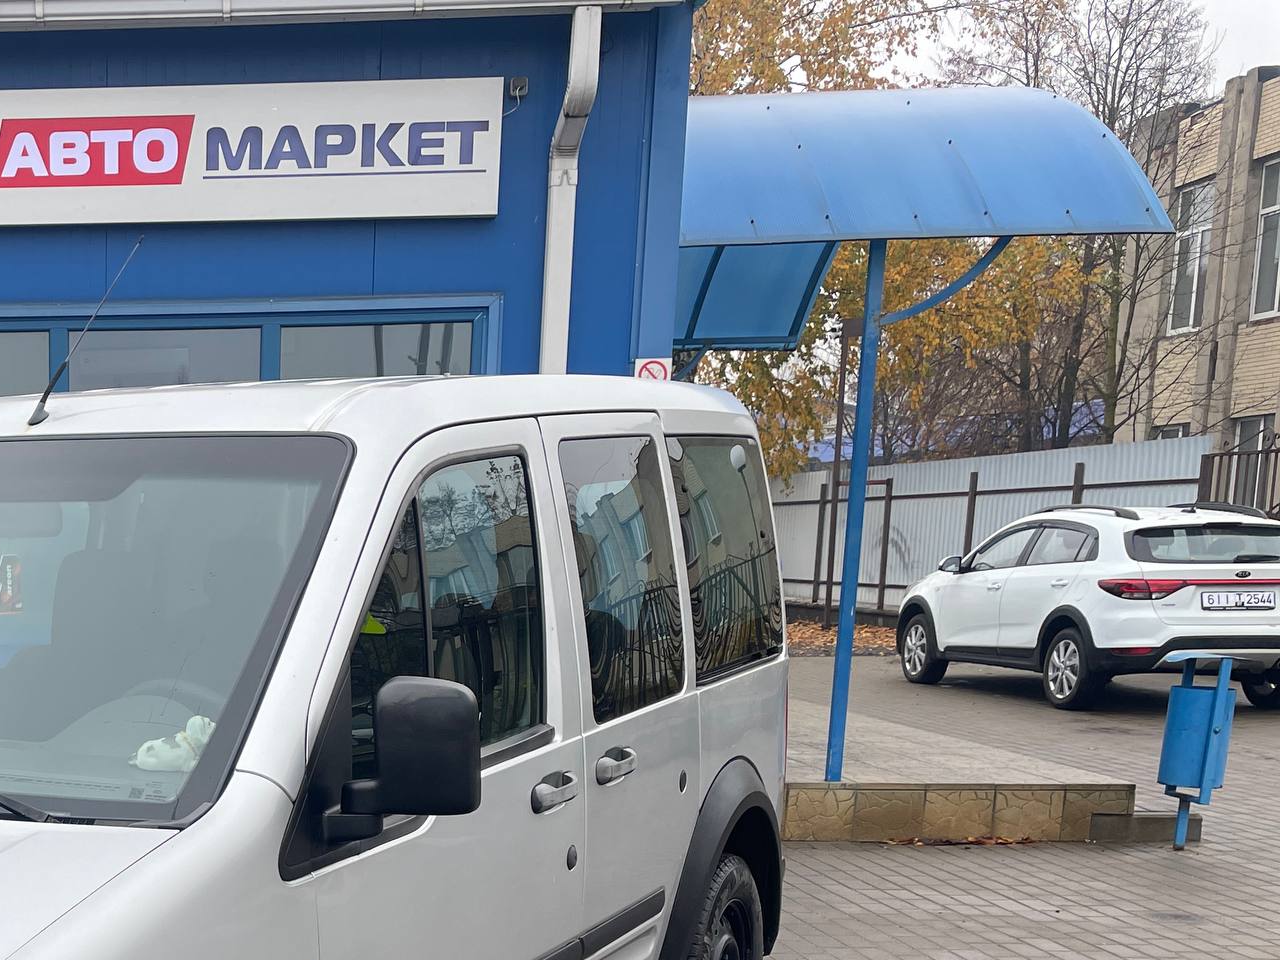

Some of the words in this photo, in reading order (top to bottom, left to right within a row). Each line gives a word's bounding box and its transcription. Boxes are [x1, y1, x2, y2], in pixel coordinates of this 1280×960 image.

[0, 128, 180, 178] АВТО
[204, 119, 490, 171] МАРКЕТ
[1246, 593, 1272, 605] 2544
